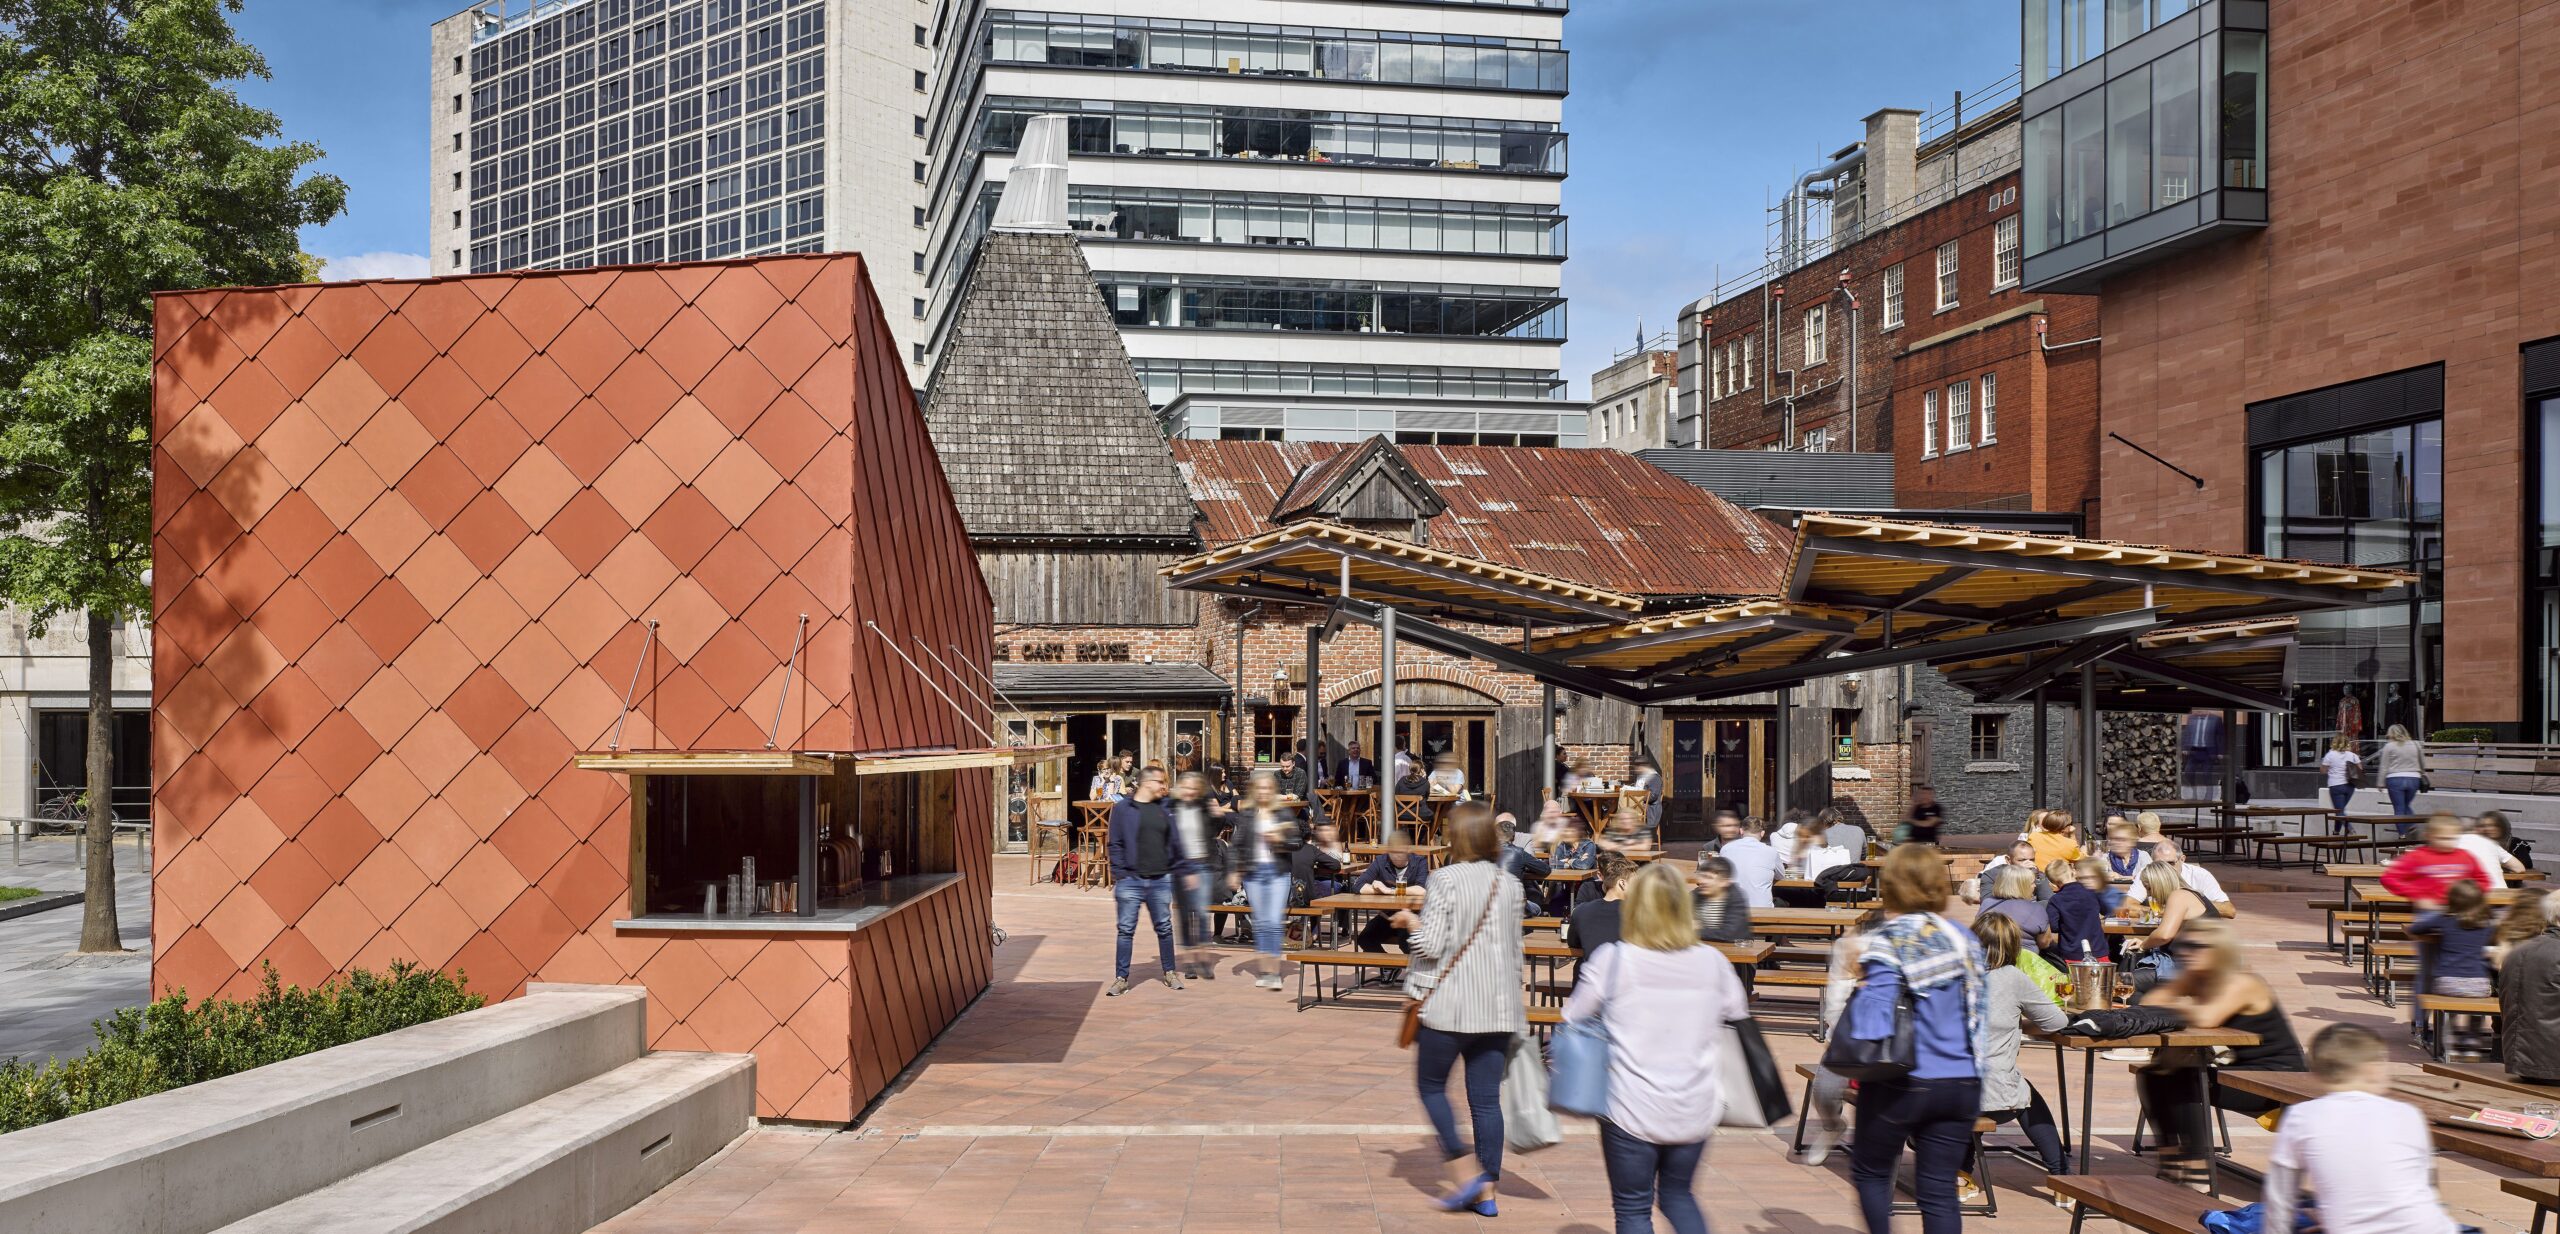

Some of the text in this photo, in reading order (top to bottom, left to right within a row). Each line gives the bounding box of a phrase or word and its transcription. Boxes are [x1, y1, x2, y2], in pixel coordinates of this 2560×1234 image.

[993, 641, 1129, 660] HE OAST HOUSE
